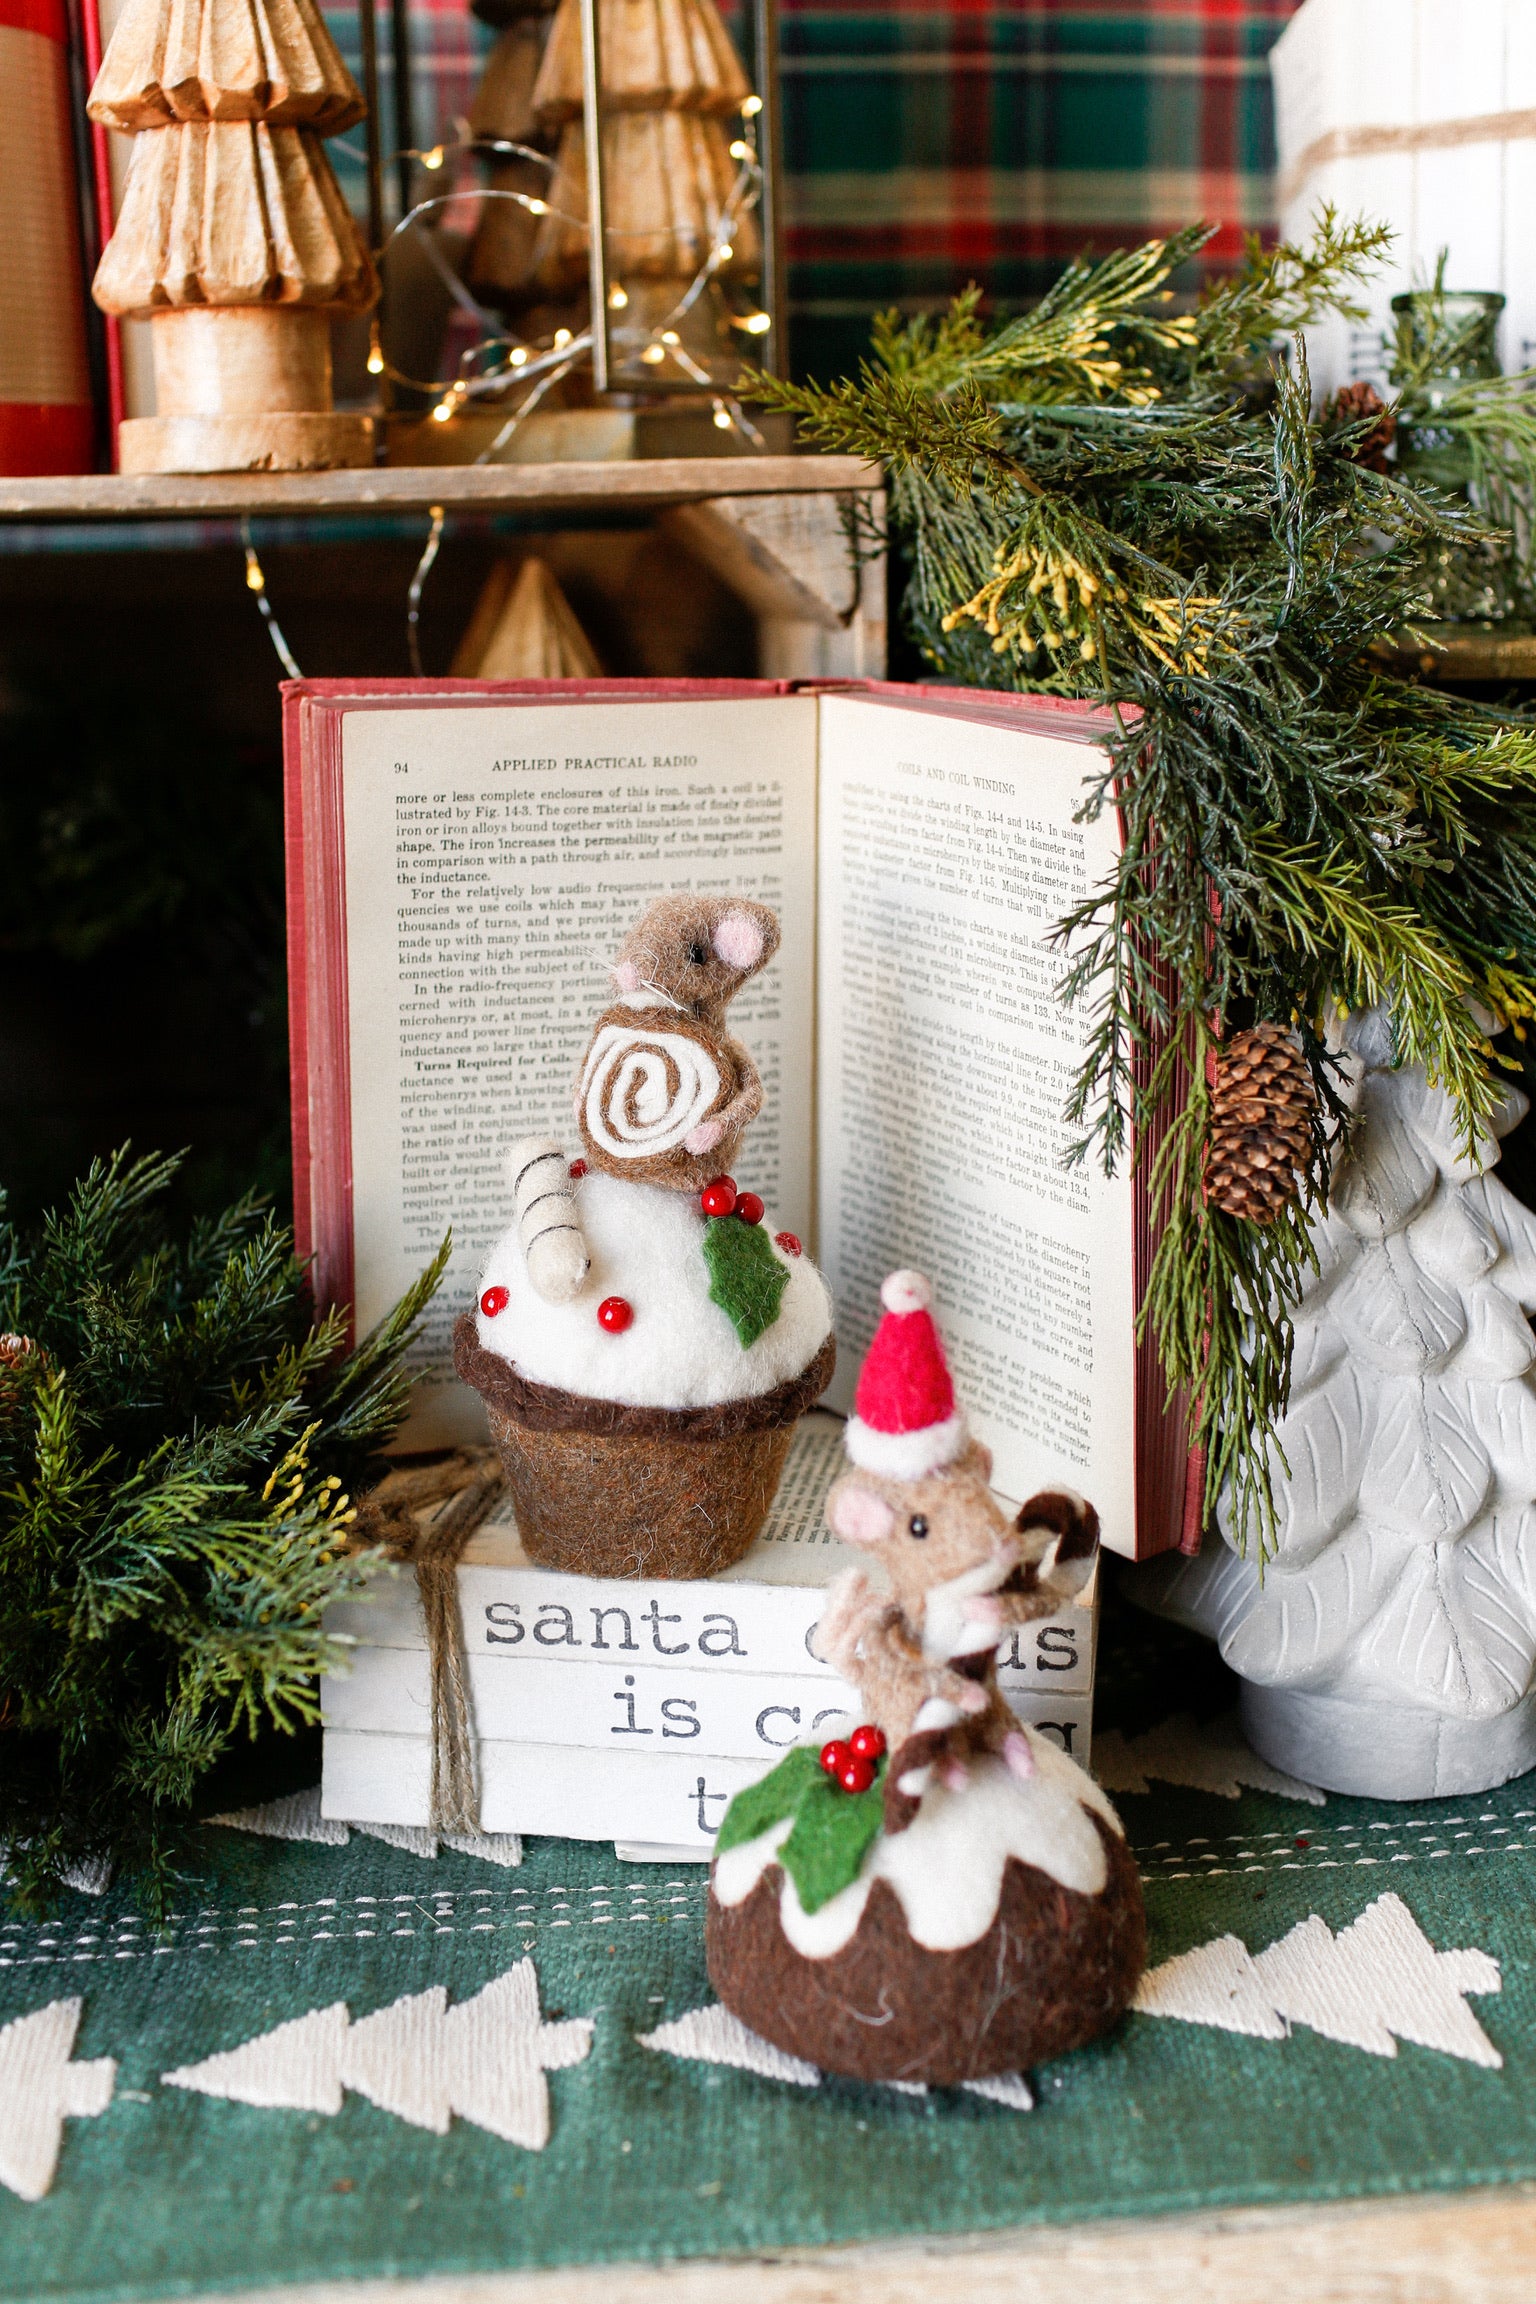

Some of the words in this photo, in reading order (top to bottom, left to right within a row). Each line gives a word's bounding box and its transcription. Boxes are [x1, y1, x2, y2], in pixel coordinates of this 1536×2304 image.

[394, 762, 408, 774] 94
[492, 758, 556, 772] APPLIED
[565, 756, 646, 770] PRACTICAL
[653, 754, 697, 767] RADIO
[927, 768, 945, 781] AND
[949, 773, 969, 786] COIL
[973, 777, 1015, 795] WINDING
[395, 794, 427, 803] more
[433, 794, 446, 802] or
[452, 790, 474, 802] less
[480, 788, 534, 803] complete
[540, 786, 602, 799] enclosures
[608, 786, 621, 797] of
[1071, 798, 1080, 810] 95
[396, 806, 451, 819] lustrated
[456, 806, 470, 820] by
[475, 805, 499, 819] Fig.
[536, 803, 560, 815] The
[563, 805, 588, 814] core
[592, 801, 642, 813] material
[396, 824, 421, 836] iron
[425, 826, 439, 835] or
[443, 822, 467, 834] iron
[471, 821, 506, 835] alloys
[511, 820, 547, 832] bound
[552, 818, 601, 833] together
[606, 817, 632, 829] with
[954, 804, 961, 813] of
[965, 805, 984, 820] Figs.
[988, 810, 1003, 824] 14-4
[1007, 816, 1021, 827] and
[1026, 819, 1044, 833] 14-5.
[1049, 824, 1057, 836] In
[1062, 829, 1084, 844] using
[396, 839, 434, 854] shape.
[440, 838, 464, 850] The
[469, 837, 493, 849] iron
[498, 835, 555, 848] increases
[561, 834, 579, 846] the
[585, 831, 658, 847] permeability
[663, 830, 676, 842] of
[973, 823, 997, 839] length
[1001, 833, 1010, 844] by
[1014, 835, 1026, 846] the
[1030, 837, 1065, 855] diameter
[1070, 849, 1085, 860] and
[396, 855, 408, 867] in
[412, 853, 484, 869] comparison
[488, 851, 515, 864] with
[520, 854, 526, 862] a
[531, 850, 558, 864] path
[562, 848, 609, 863] through
[1007, 848, 1027, 863] Then
[1031, 856, 1042, 866] we
[1045, 857, 1070, 873] divide
[1073, 865, 1086, 877] the
[397, 871, 416, 883] the
[421, 868, 490, 882] inductance.
[998, 864, 1030, 882] winding
[1032, 872, 1068, 890] diameter
[1071, 883, 1086, 895] and
[411, 886, 434, 898] For
[441, 885, 460, 897] the
[466, 883, 524, 898] relatively
[531, 883, 551, 895] low
[558, 881, 591, 894] audio
[1002, 884, 1048, 904] Multiplying
[1053, 894, 1066, 907] the
[397, 902, 449, 917] quencies
[456, 904, 473, 913] we
[479, 903, 499, 912] use
[505, 898, 532, 910] coils
[538, 898, 574, 910] which
[581, 899, 605, 911] may
[612, 895, 638, 907] have
[983, 893, 1003, 906] turns
[1008, 899, 1023, 912] that
[1027, 906, 1042, 917] will
[1045, 908, 1054, 920] be
[397, 917, 460, 931] thousands
[466, 916, 479, 928] of
[527, 915, 548, 927] and
[556, 917, 572, 926] we
[578, 911, 623, 927] provide
[398, 934, 431, 947] made
[435, 937, 450, 948] up
[455, 932, 482, 945] with
[487, 934, 519, 945] many
[525, 931, 549, 943] thin
[970, 921, 994, 936] charts
[1011, 933, 1028, 946] shall
[398, 950, 431, 963] kinds
[438, 948, 480, 964] having
[486, 947, 513, 961] high
[977, 940, 1007, 958] winding
[1010, 950, 1045, 968] diameter
[398, 964, 463, 978] connection
[469, 963, 496, 975] with
[501, 962, 520, 974] the
[525, 960, 567, 975] subject
[1020, 967, 1038, 982] This
[414, 982, 427, 994] In
[433, 981, 452, 993] the
[459, 976, 554, 994] radio-frequency
[1017, 982, 1055, 1004] computed
[399, 997, 439, 1009] cerned
[448, 995, 475, 1007] with
[995, 992, 1016, 1009] turns
[1034, 1004, 1050, 1019] 133.
[1055, 1010, 1074, 1026] Now
[1079, 1021, 1091, 1032] we
[399, 1010, 476, 1027] microhenrys
[989, 1007, 1034, 1030] comparison
[1038, 1023, 1057, 1037] with
[1061, 1031, 1075, 1046] the
[399, 1030, 441, 1042] quency
[400, 1041, 471, 1055] inductances
[1012, 1047, 1051, 1069] diameter.
[414, 1057, 450, 1070] Turns
[457, 1054, 511, 1070] Required
[1016, 1064, 1031, 1079] line
[1035, 1071, 1047, 1083] for
[1051, 1076, 1063, 1090] 2.0
[1039, 1088, 1062, 1105] lower
[1004, 1109, 1047, 1134] inductance
[1030, 1103, 1056, 1122] maybe
[402, 1149, 449, 1163] formula
[1014, 1145, 1048, 1166] straight
[1006, 1156, 1030, 1175] factor
[1044, 1170, 1068, 1190] about
[402, 1178, 448, 1192] number
[1067, 1198, 1091, 1214] diam-
[1042, 1236, 1090, 1263] microhenry
[1042, 1251, 1079, 1274] diameter
[1073, 1281, 1091, 1295] root
[1055, 1302, 1083, 1323] merely
[1061, 1320, 1093, 1341] number
[1042, 1391, 1078, 1416] extended
[1067, 1388, 1091, 1407] which
[485, 1599, 748, 1656] santa
[609, 1674, 701, 1738] is
